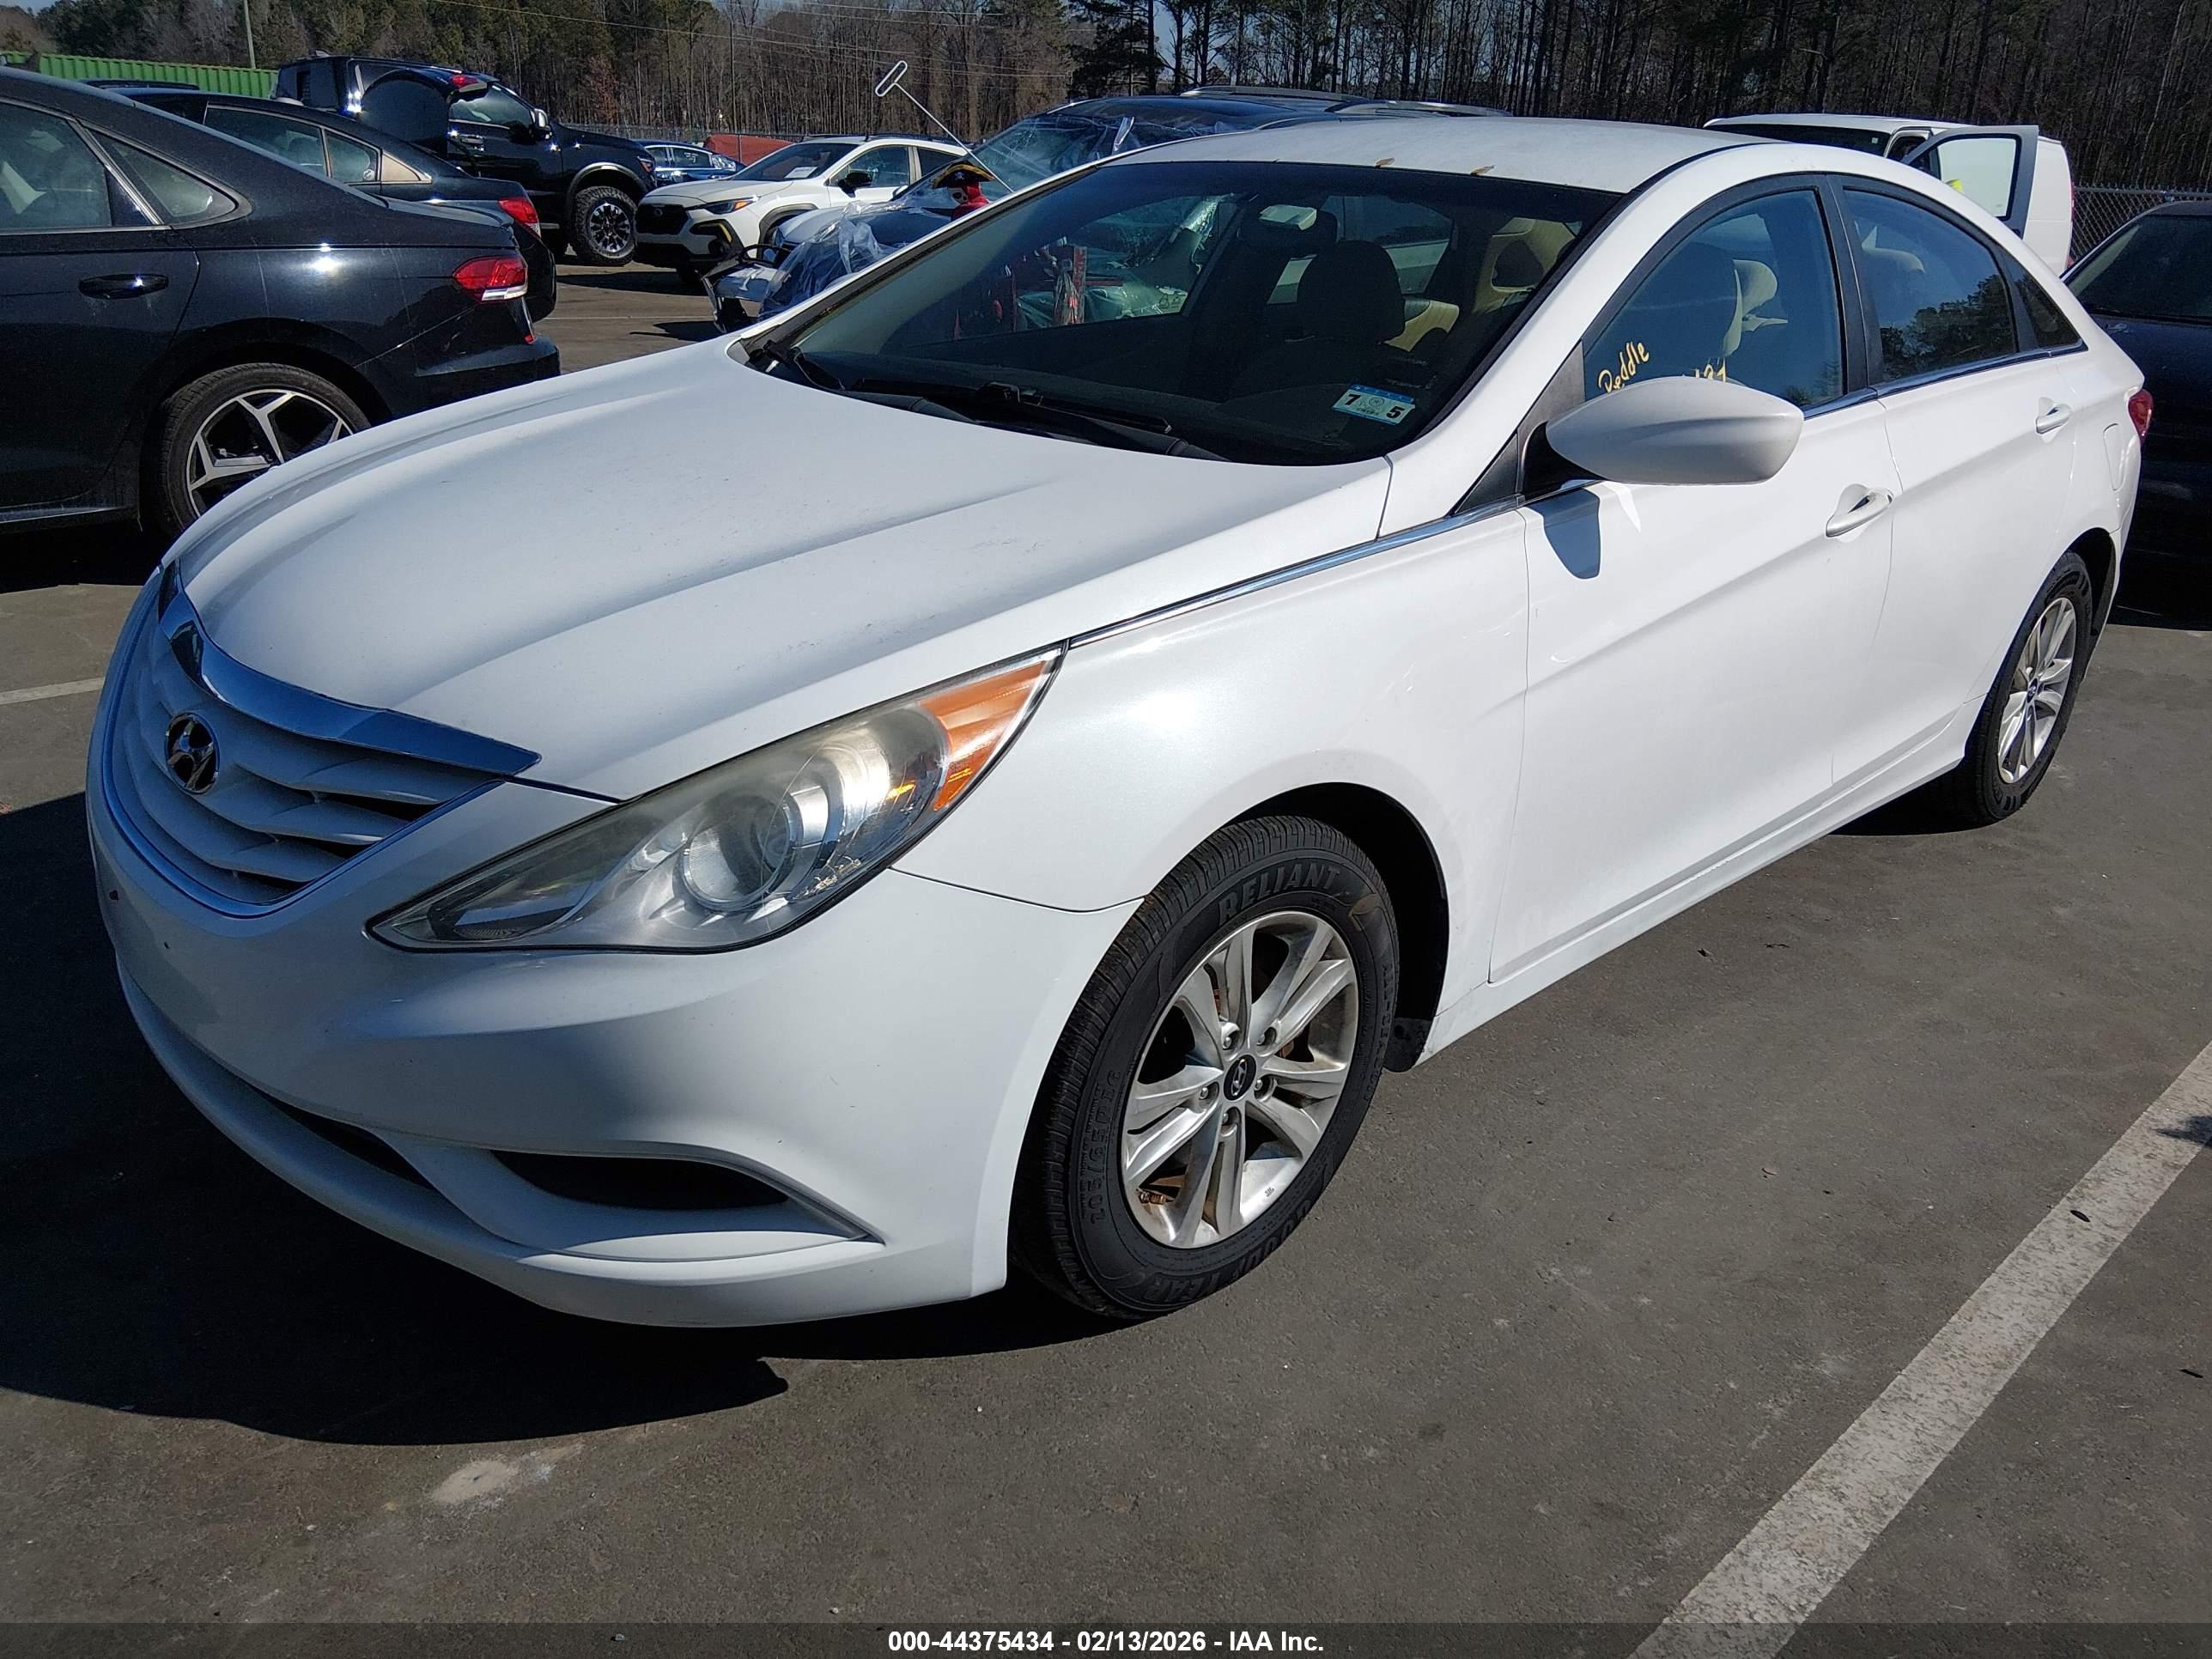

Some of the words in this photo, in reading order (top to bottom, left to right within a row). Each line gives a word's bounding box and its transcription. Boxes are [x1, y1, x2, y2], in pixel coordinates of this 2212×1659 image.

[1345, 393, 1361, 406] 7
[1386, 405, 1406, 419] 5
[1218, 862, 1341, 927] RELIANT
